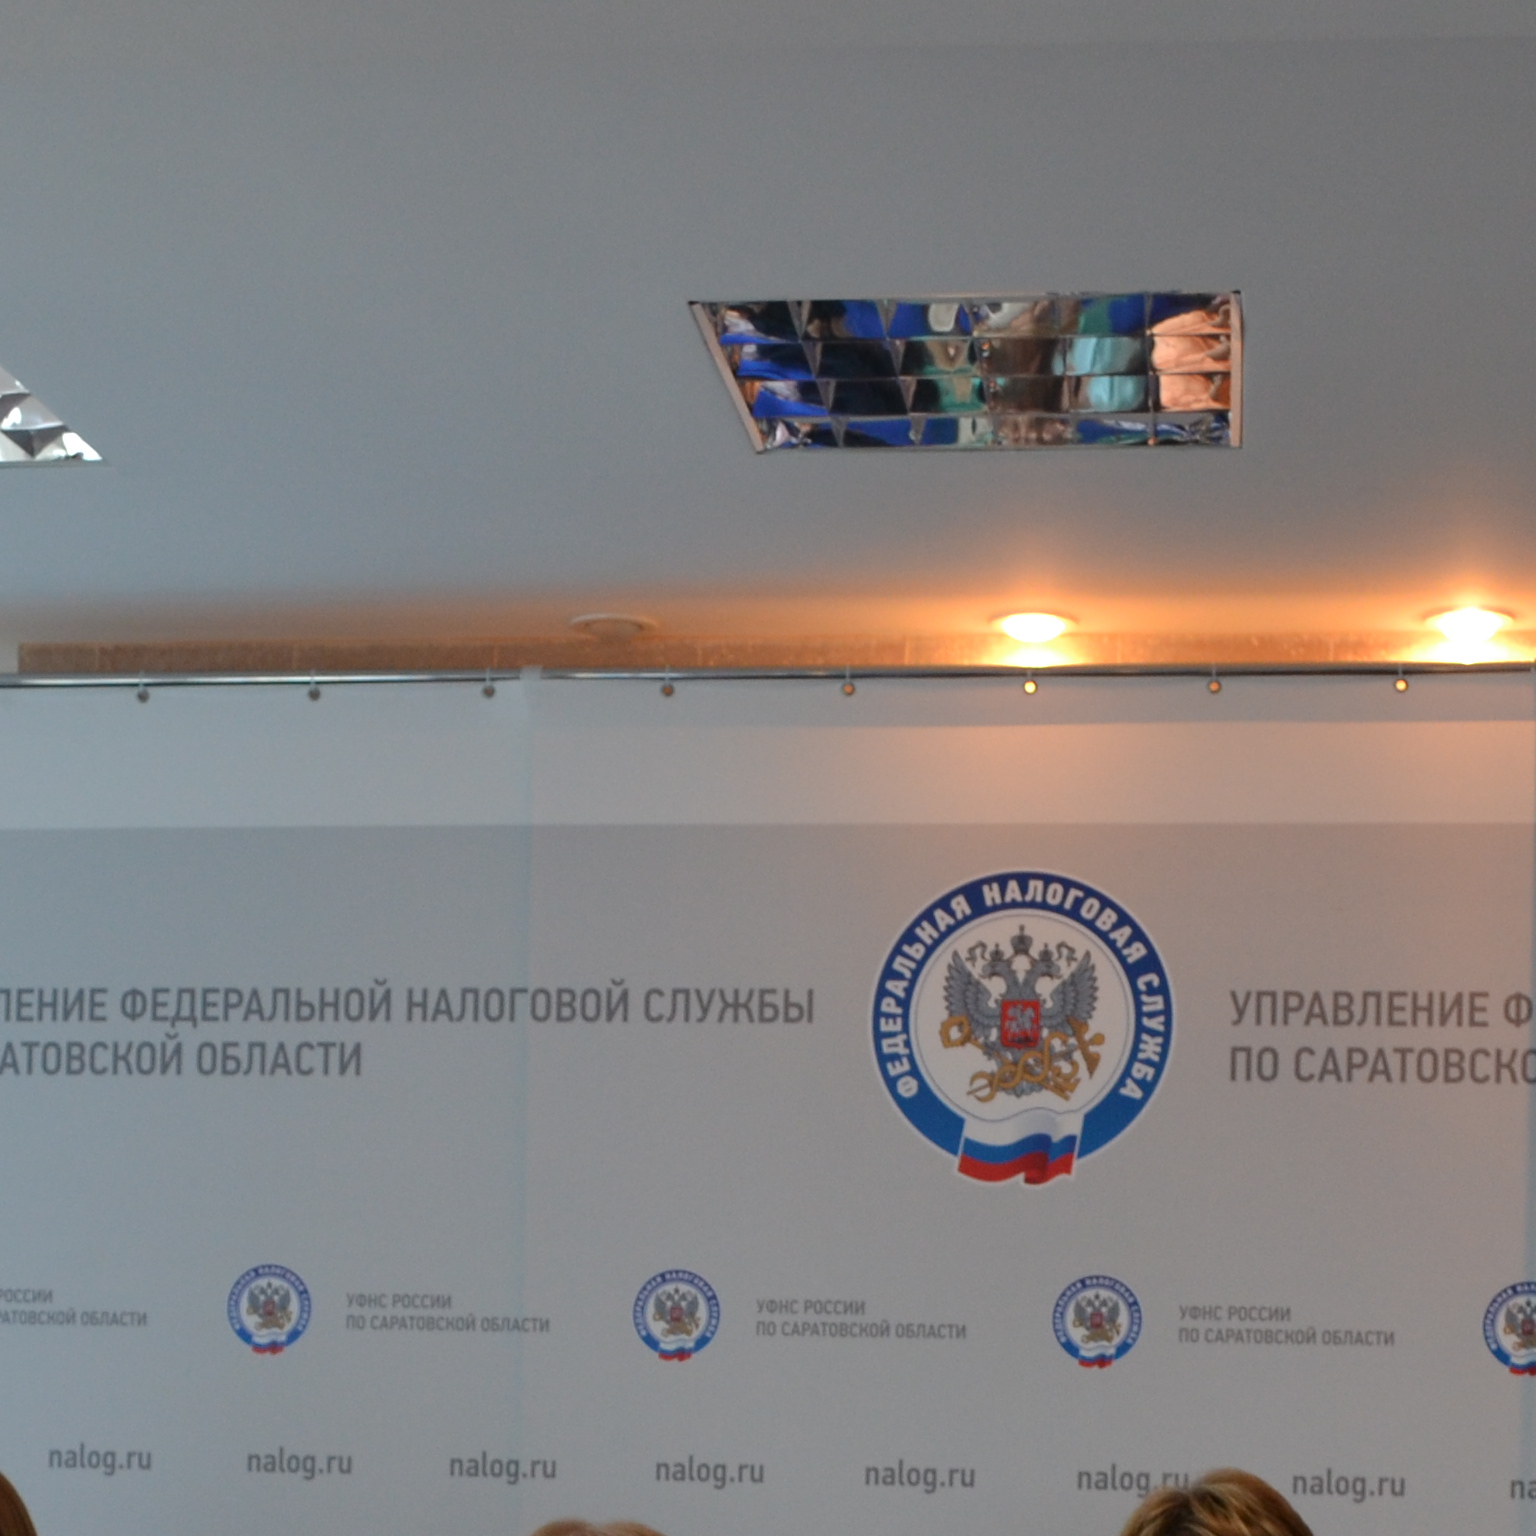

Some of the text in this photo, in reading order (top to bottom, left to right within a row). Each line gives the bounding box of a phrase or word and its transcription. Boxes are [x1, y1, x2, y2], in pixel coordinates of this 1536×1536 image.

[120, 979, 391, 1029] ФЕДЕРАЛЬНОЙ
[406, 979, 629, 1023] НАЛОГОВОЙ
[644, 988, 814, 1024] СЛУЖБЫ
[880, 879, 1165, 1100] ФЕДЕРАЛЬНАЯ НАЛОГОВАЯ СЛУЖБА
[1230, 990, 1489, 1028] УПРАВЛЕНИЕ
[196, 1041, 362, 1076] ОБЛАСТИ
[1230, 1046, 1279, 1082] ПО
[347, 1293, 452, 1309] УФНС РОССИИ
[757, 1299, 866, 1315] УФНС РОССИИ
[1179, 1305, 1291, 1322] УФНС РОССИИ
[80, 1311, 148, 1327] ОБЛАСТИ
[346, 1313, 550, 1333] ПО САРАТОВСКОЙ ОБЛАСТИ
[756, 1319, 967, 1339] ПО САРАТОВСКОЙ ОБЛАСТИ
[1178, 1326, 1395, 1346] ПО САРАТОВСКОЙ ОБЛАСТИ
[48, 1442, 152, 1477] nalog.ru
[247, 1446, 352, 1481] nalog.ru
[450, 1451, 557, 1486] nalog.ru
[656, 1455, 764, 1490] nalog.ru
[865, 1459, 975, 1495] nalog.ru
[1292, 1468, 1405, 1504] nalog.ru
